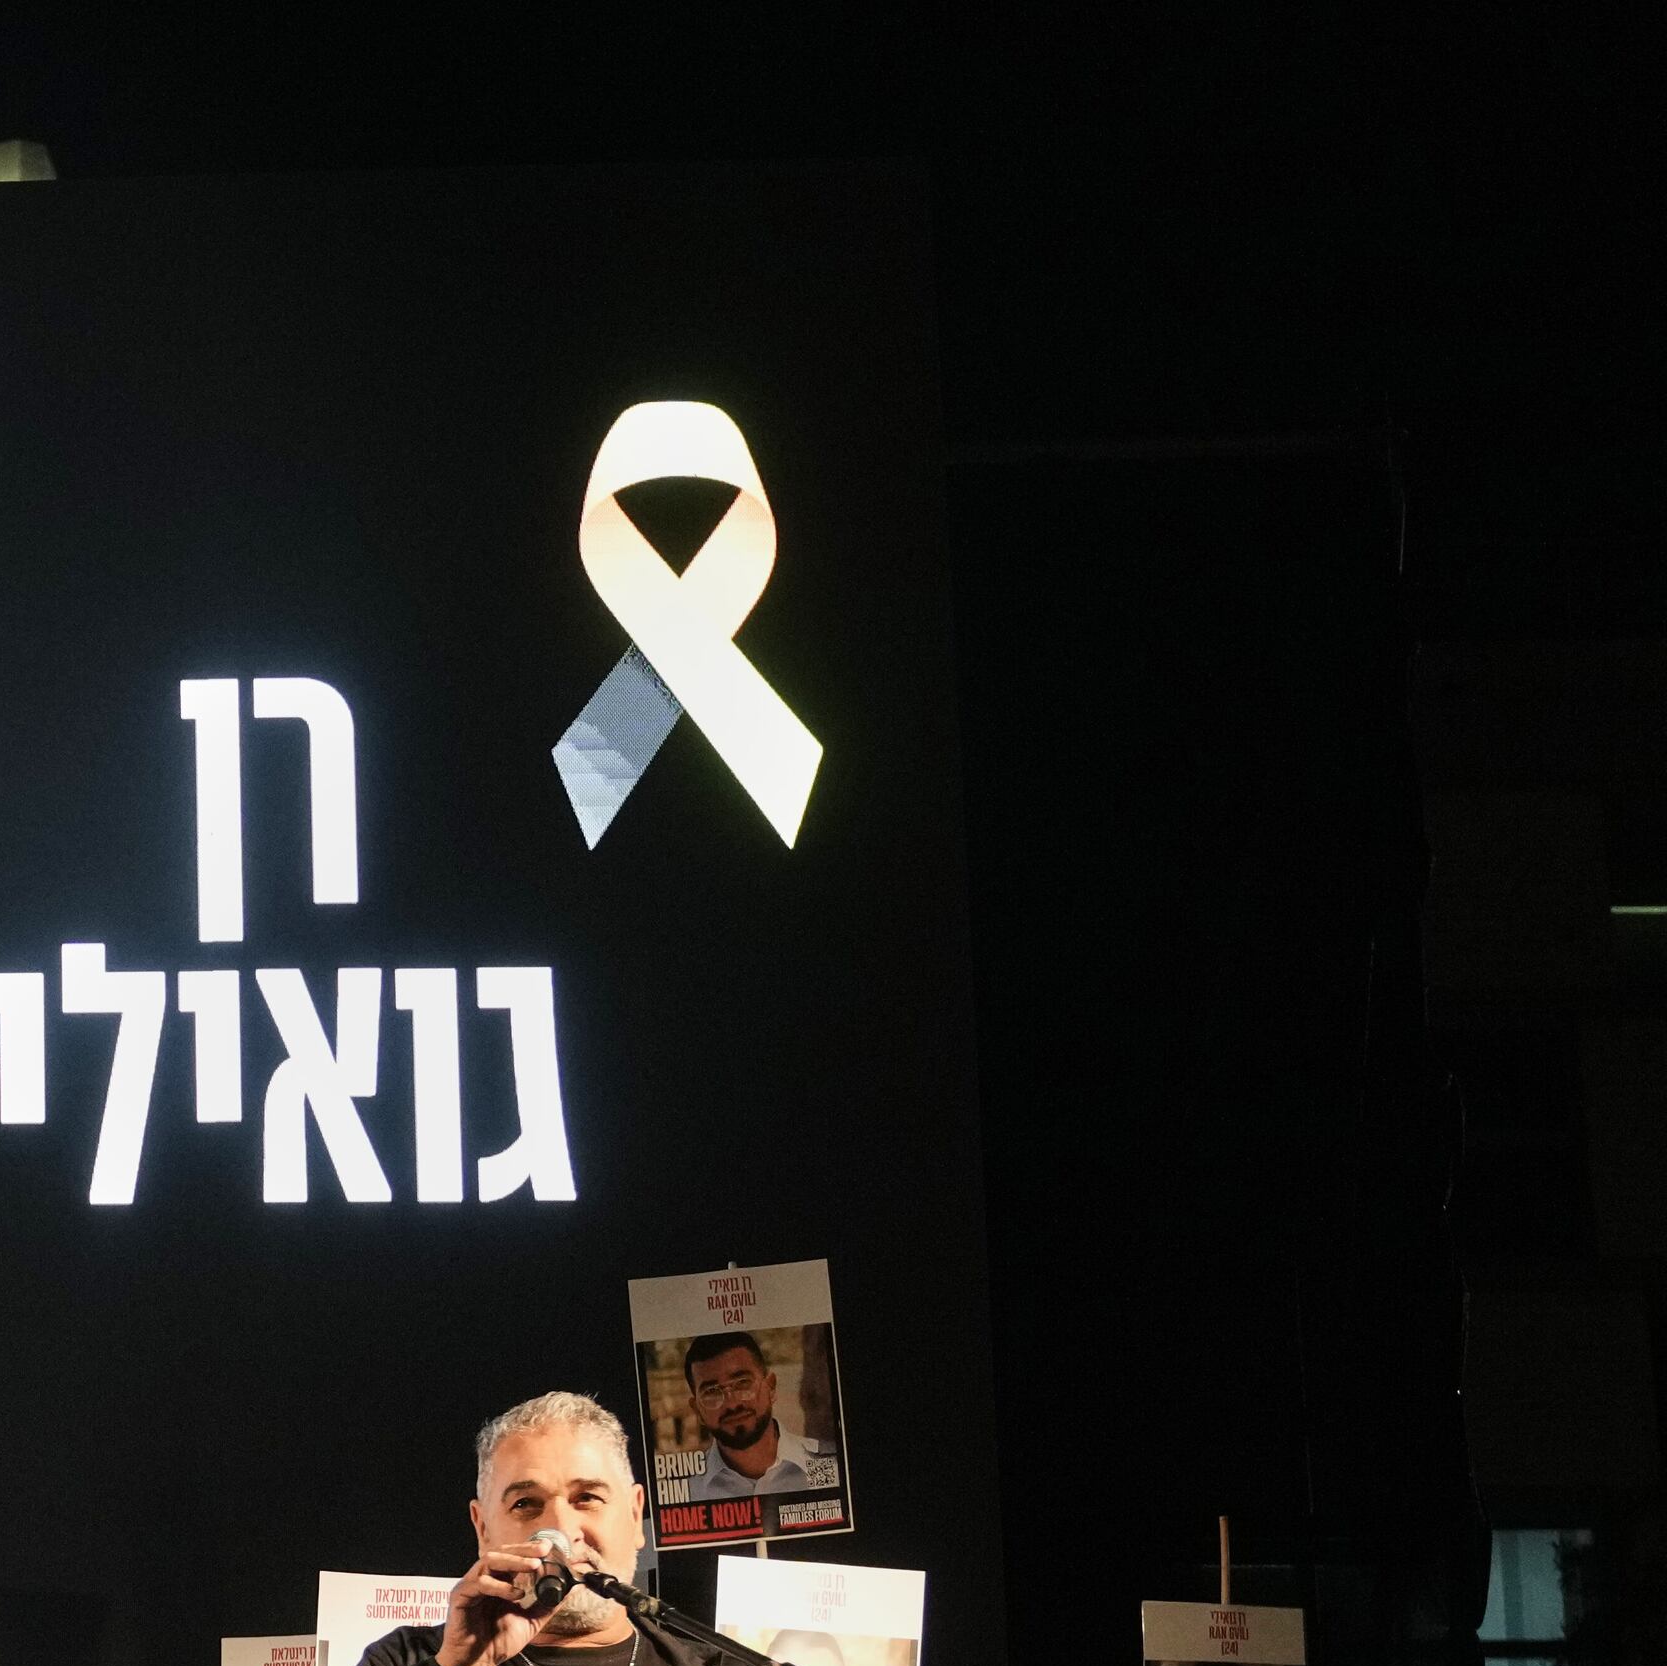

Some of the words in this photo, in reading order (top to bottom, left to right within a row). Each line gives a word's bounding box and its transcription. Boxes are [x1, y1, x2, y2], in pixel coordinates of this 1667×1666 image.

[180, 677, 359, 942] רן
[709, 1277, 740, 1293] גואילי
[708, 1295, 729, 1310] RAN
[731, 1292, 756, 1307] GVILI
[723, 1308, 744, 1325] (24)
[654, 1450, 707, 1480] BRING
[657, 1479, 691, 1505] HIM
[661, 1505, 708, 1534] HOME
[712, 1497, 761, 1528] NOW!
[779, 1510, 814, 1525] FAMILIES
[816, 1507, 843, 1521] FORUM
[366, 1604, 421, 1619] SUDTHISAK
